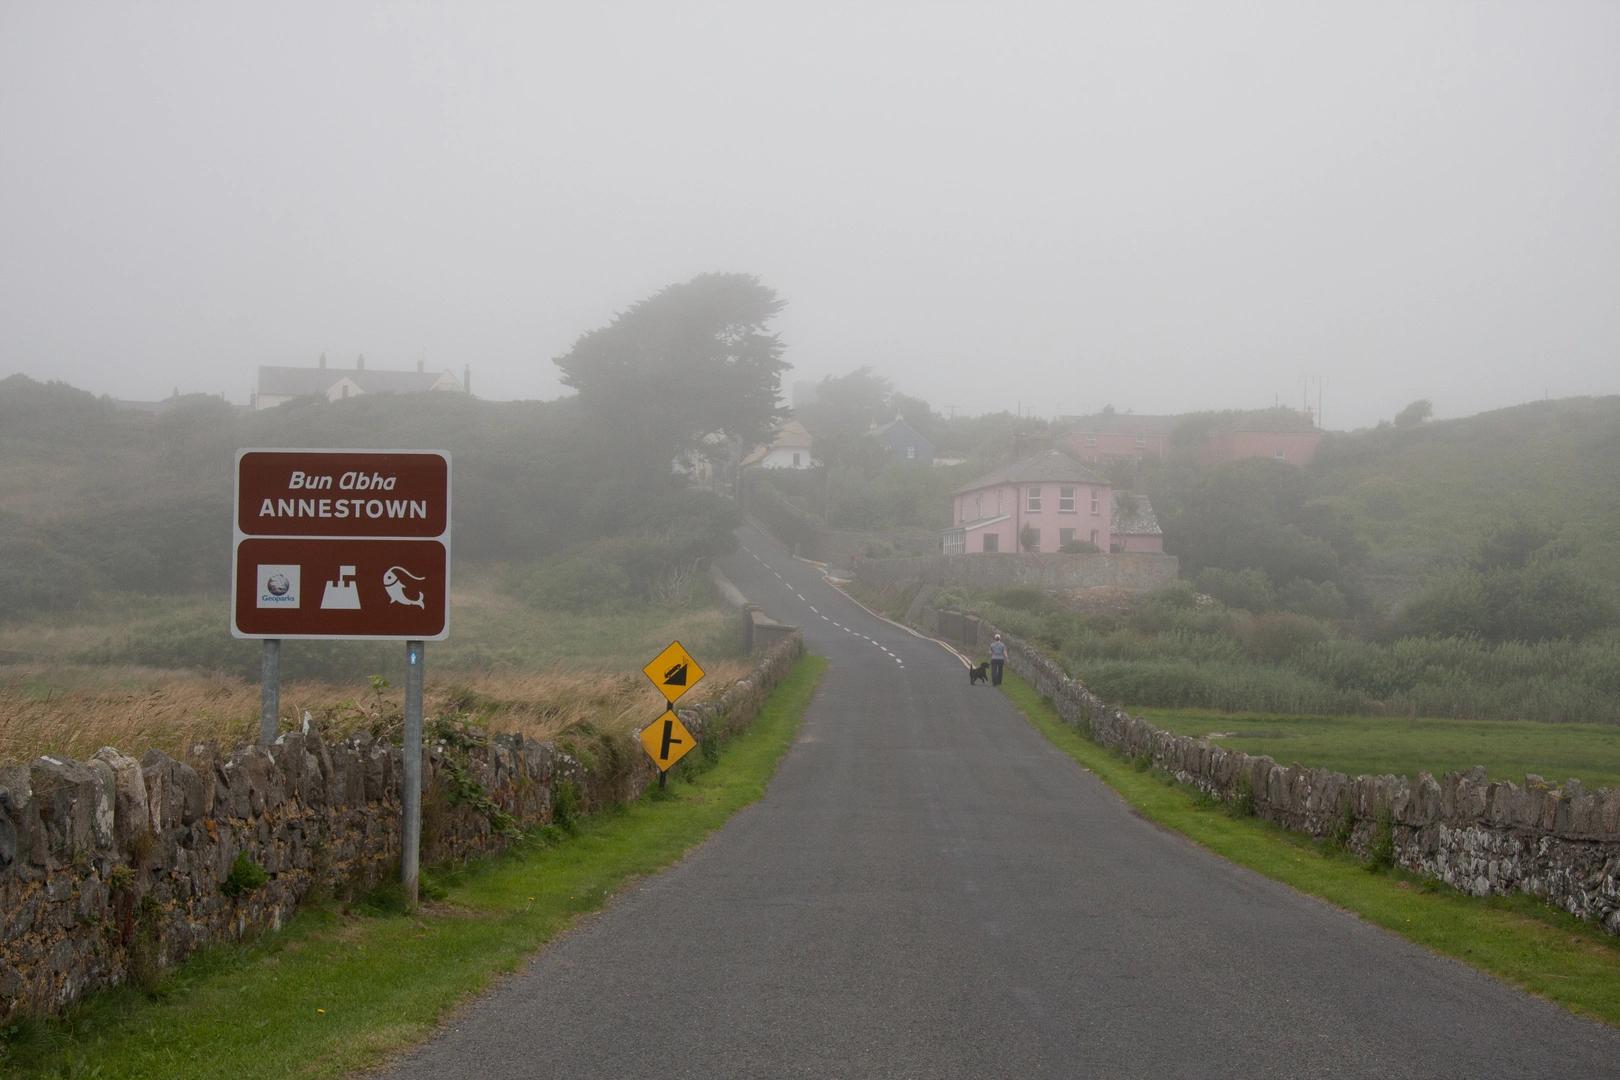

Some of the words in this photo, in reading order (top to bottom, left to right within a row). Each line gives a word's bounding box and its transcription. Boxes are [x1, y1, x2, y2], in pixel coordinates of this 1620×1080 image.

[288, 471, 333, 490] Bun
[259, 498, 427, 519] ANNESTOWN
[262, 594, 295, 603] Geoparks
